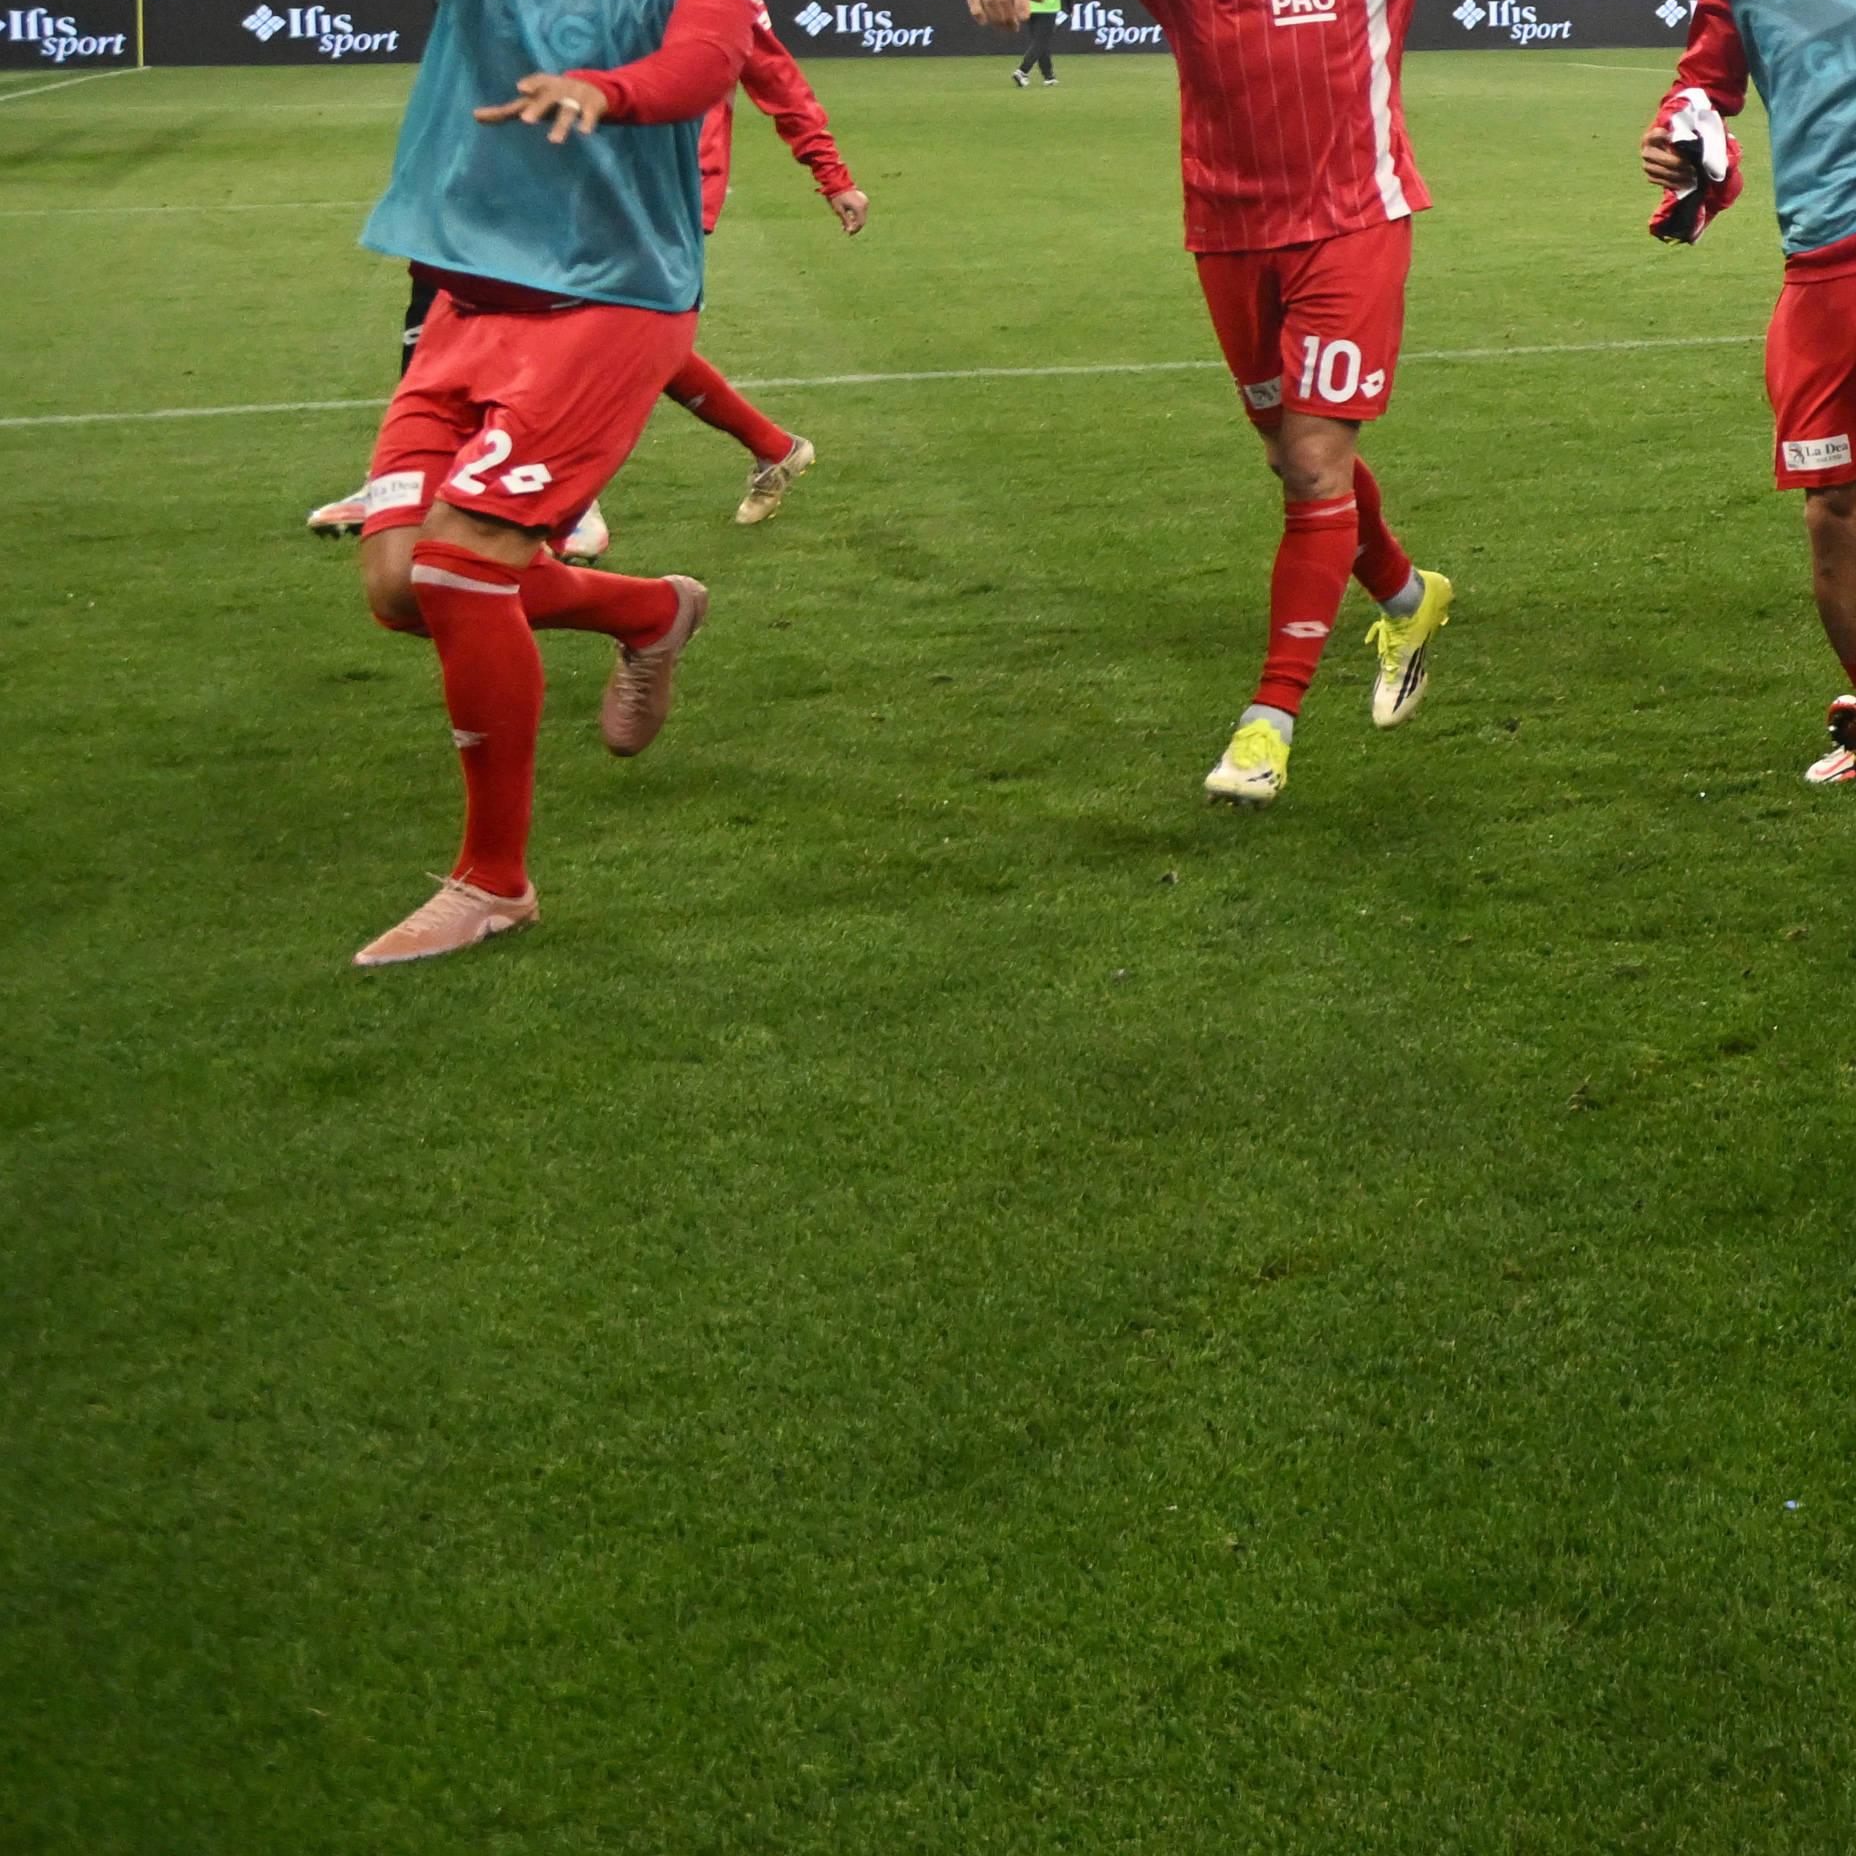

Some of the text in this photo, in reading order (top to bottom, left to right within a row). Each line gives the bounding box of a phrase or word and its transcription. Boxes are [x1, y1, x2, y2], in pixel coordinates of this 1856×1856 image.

[9, 9, 77, 41] Ifis
[288, 5, 353, 37] Ifis
[836, 2, 891, 33] Ifis
[1070, 0, 1124, 29] Ifis
[320, 29, 400, 59] sport
[863, 24, 933, 53] sport
[1096, 21, 1162, 51] sport
[1511, 17, 1572, 46] sport
[42, 33, 126, 62] sport
[1300, 336, 1362, 404] 10
[450, 430, 511, 494] 2
[1806, 443, 1849, 457] La Dea
